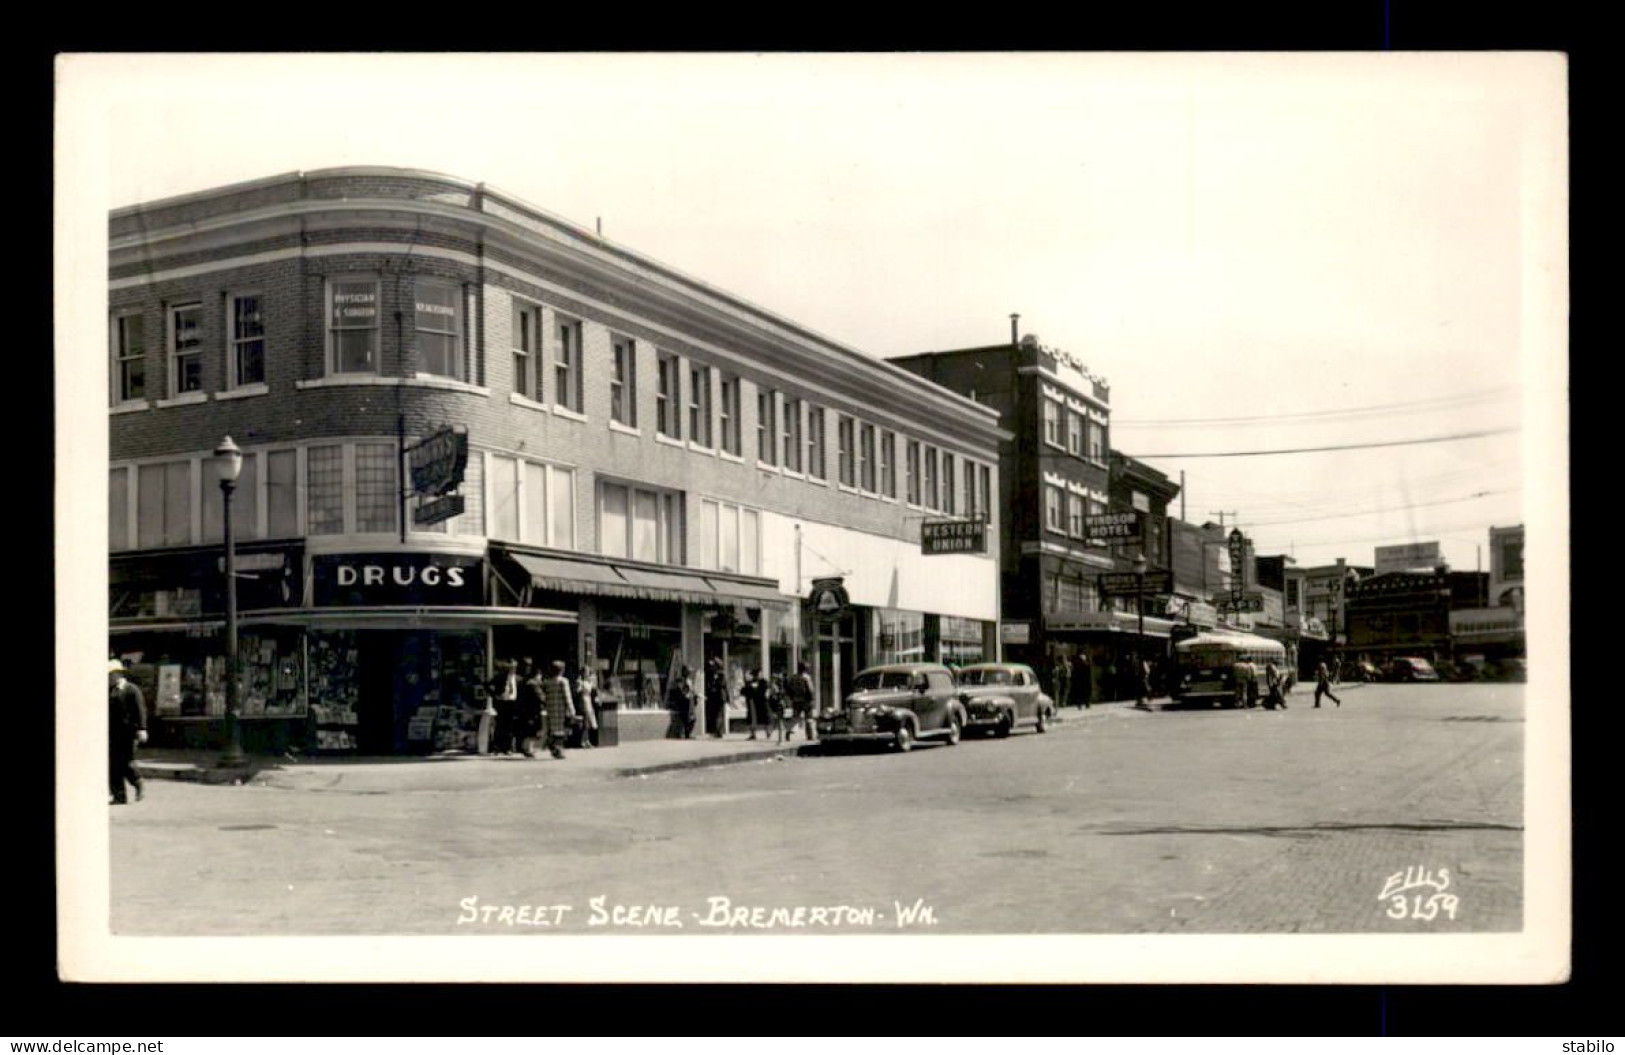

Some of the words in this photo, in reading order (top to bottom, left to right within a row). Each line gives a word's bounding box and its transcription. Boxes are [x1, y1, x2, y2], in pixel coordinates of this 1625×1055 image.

[335, 293, 375, 304] PHYSICIAN
[1085, 512, 1136, 526] WINDSOR
[924, 523, 983, 537] WESTERN
[1089, 524, 1132, 537] HOTEL
[932, 538, 973, 551] UNION
[337, 565, 466, 587] DRUGS
[1386, 893, 1459, 921] 3159
